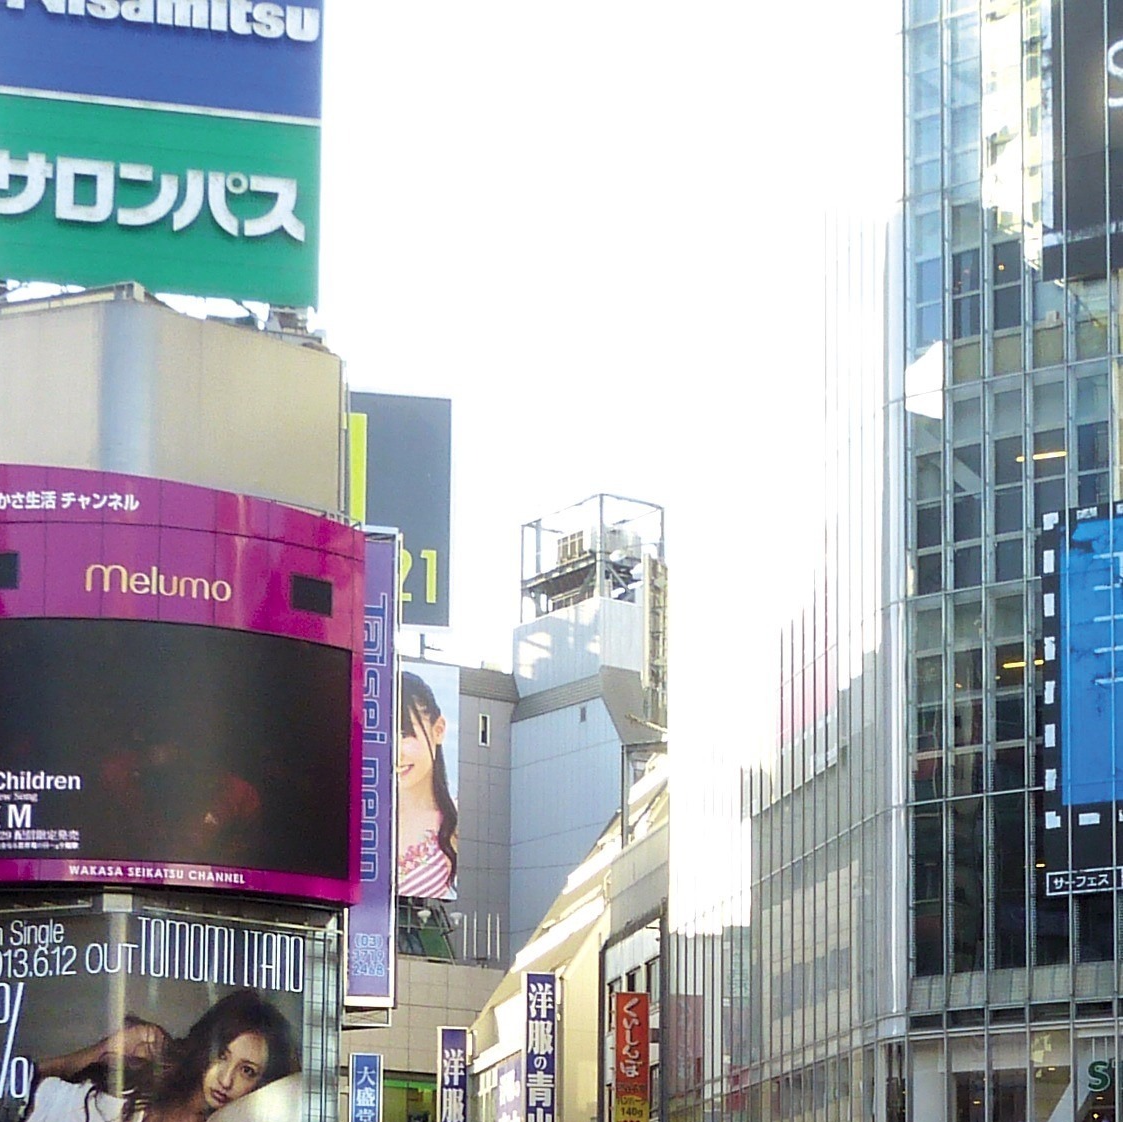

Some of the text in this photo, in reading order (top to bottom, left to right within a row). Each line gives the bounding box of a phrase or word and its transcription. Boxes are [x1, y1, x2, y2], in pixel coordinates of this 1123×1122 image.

[7, 0, 321, 42] samitsu
[60, 492, 139, 512] チャンネル
[362, 593, 388, 744] Taisei
[68, 864, 246, 884] WAKASA SEIKATSU CHANNEL
[1053, 874, 1110, 890] サーフェス
[9, 919, 64, 949] Single
[85, 942, 139, 974] OUT
